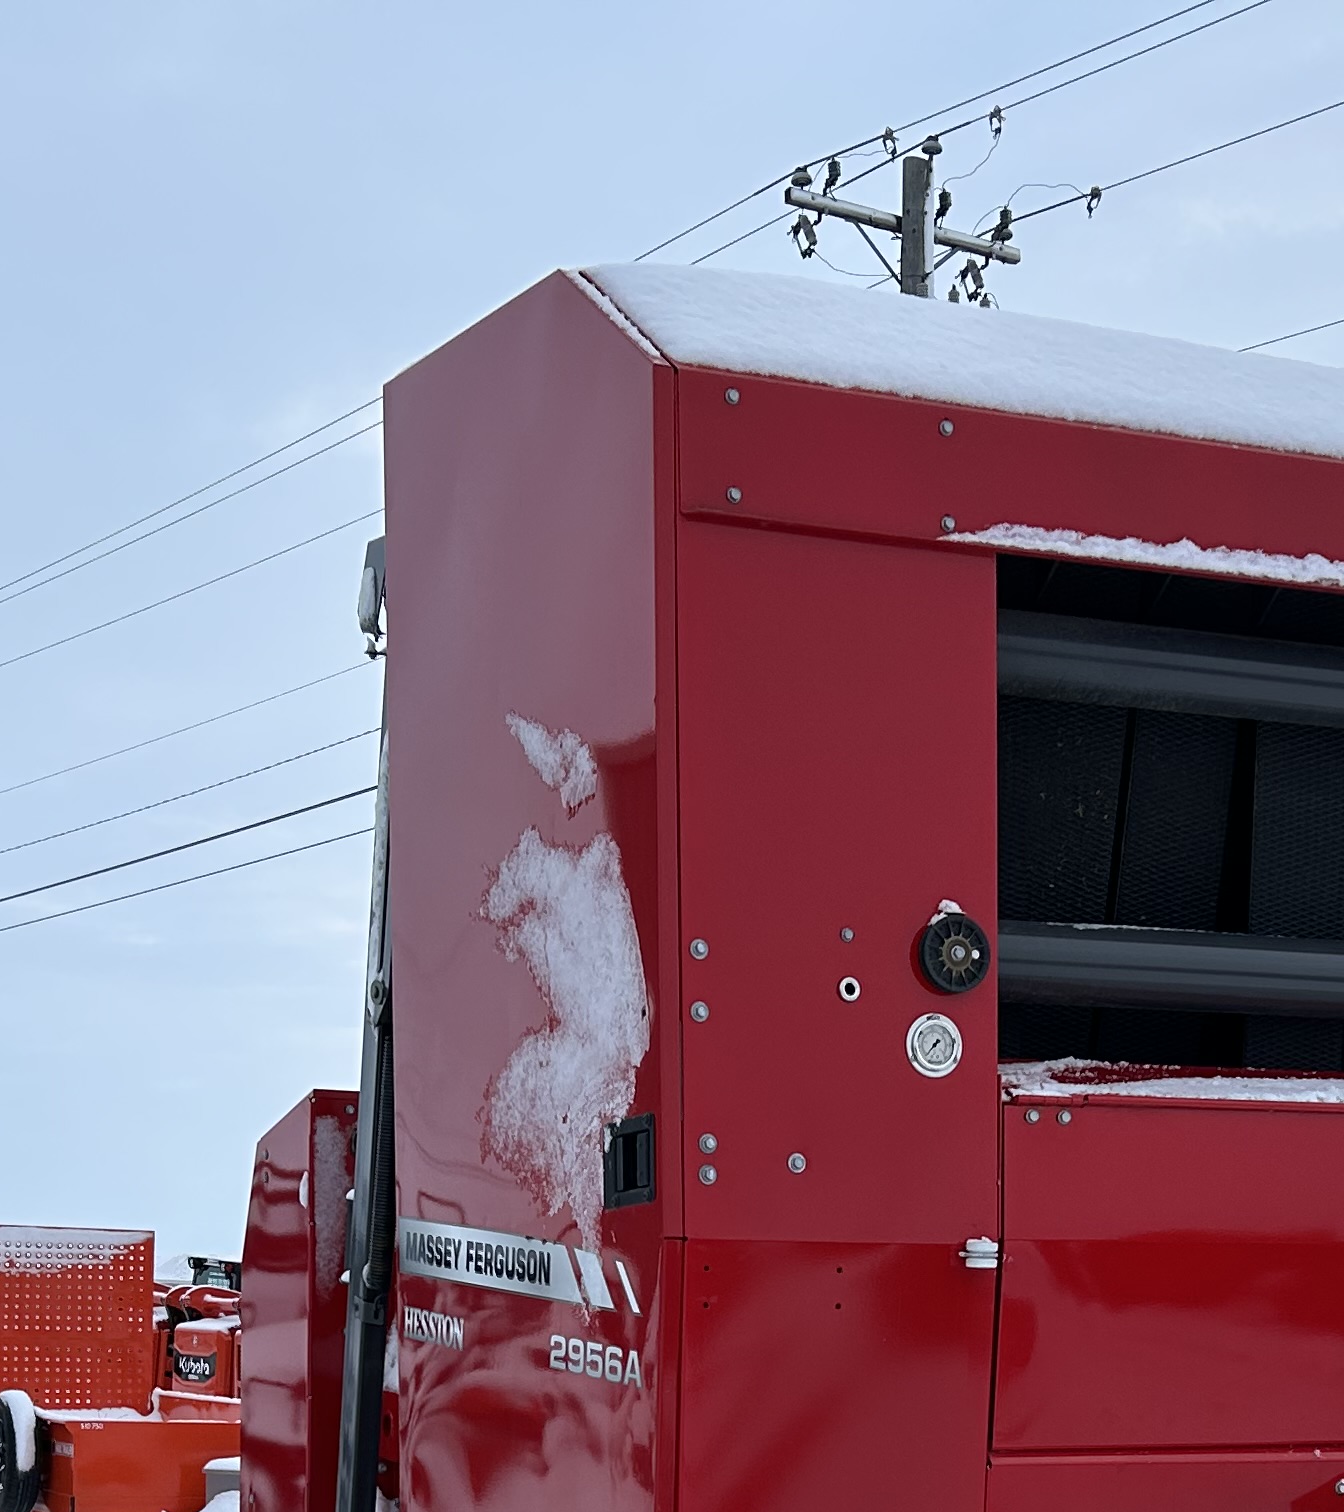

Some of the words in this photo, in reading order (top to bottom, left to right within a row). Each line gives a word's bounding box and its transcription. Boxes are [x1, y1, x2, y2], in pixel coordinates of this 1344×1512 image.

[406, 1231, 462, 1270] MASSEY
[465, 1240, 551, 1286] FERGUSON
[404, 1306, 464, 1350] HESSTON
[179, 1356, 210, 1375] Kubota
[549, 1334, 642, 1388] 2956A
